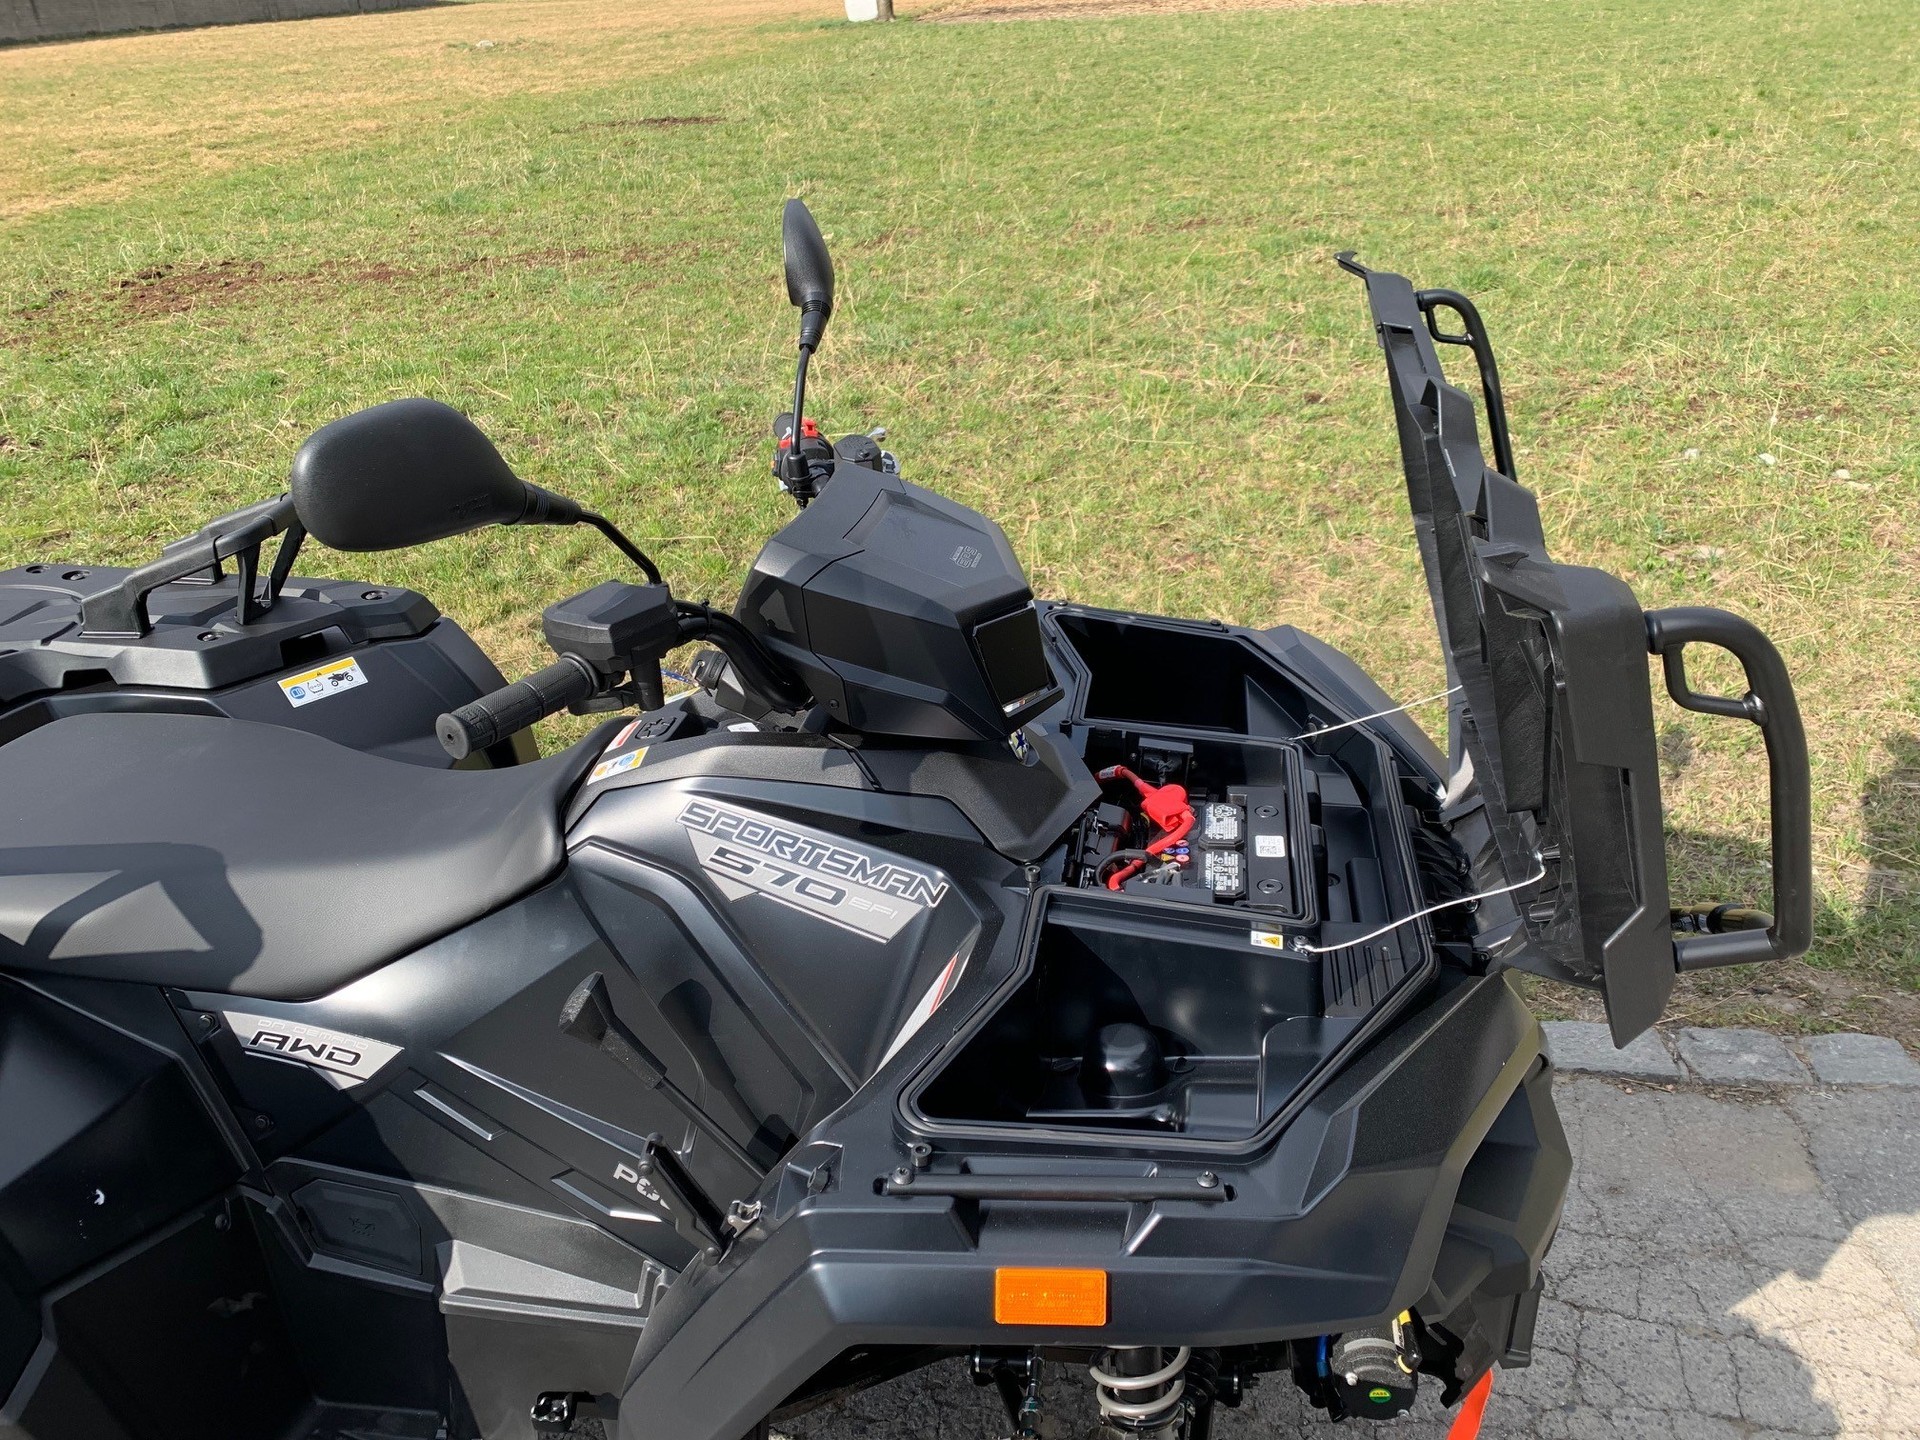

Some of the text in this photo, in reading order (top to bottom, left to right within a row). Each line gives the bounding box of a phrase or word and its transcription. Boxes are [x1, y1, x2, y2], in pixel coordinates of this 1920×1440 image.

[677, 801, 948, 907] SPORTSMAN
[705, 845, 898, 920] 570 EFI
[249, 1031, 362, 1066] AWD
[293, 1025, 369, 1049] DEMAND
